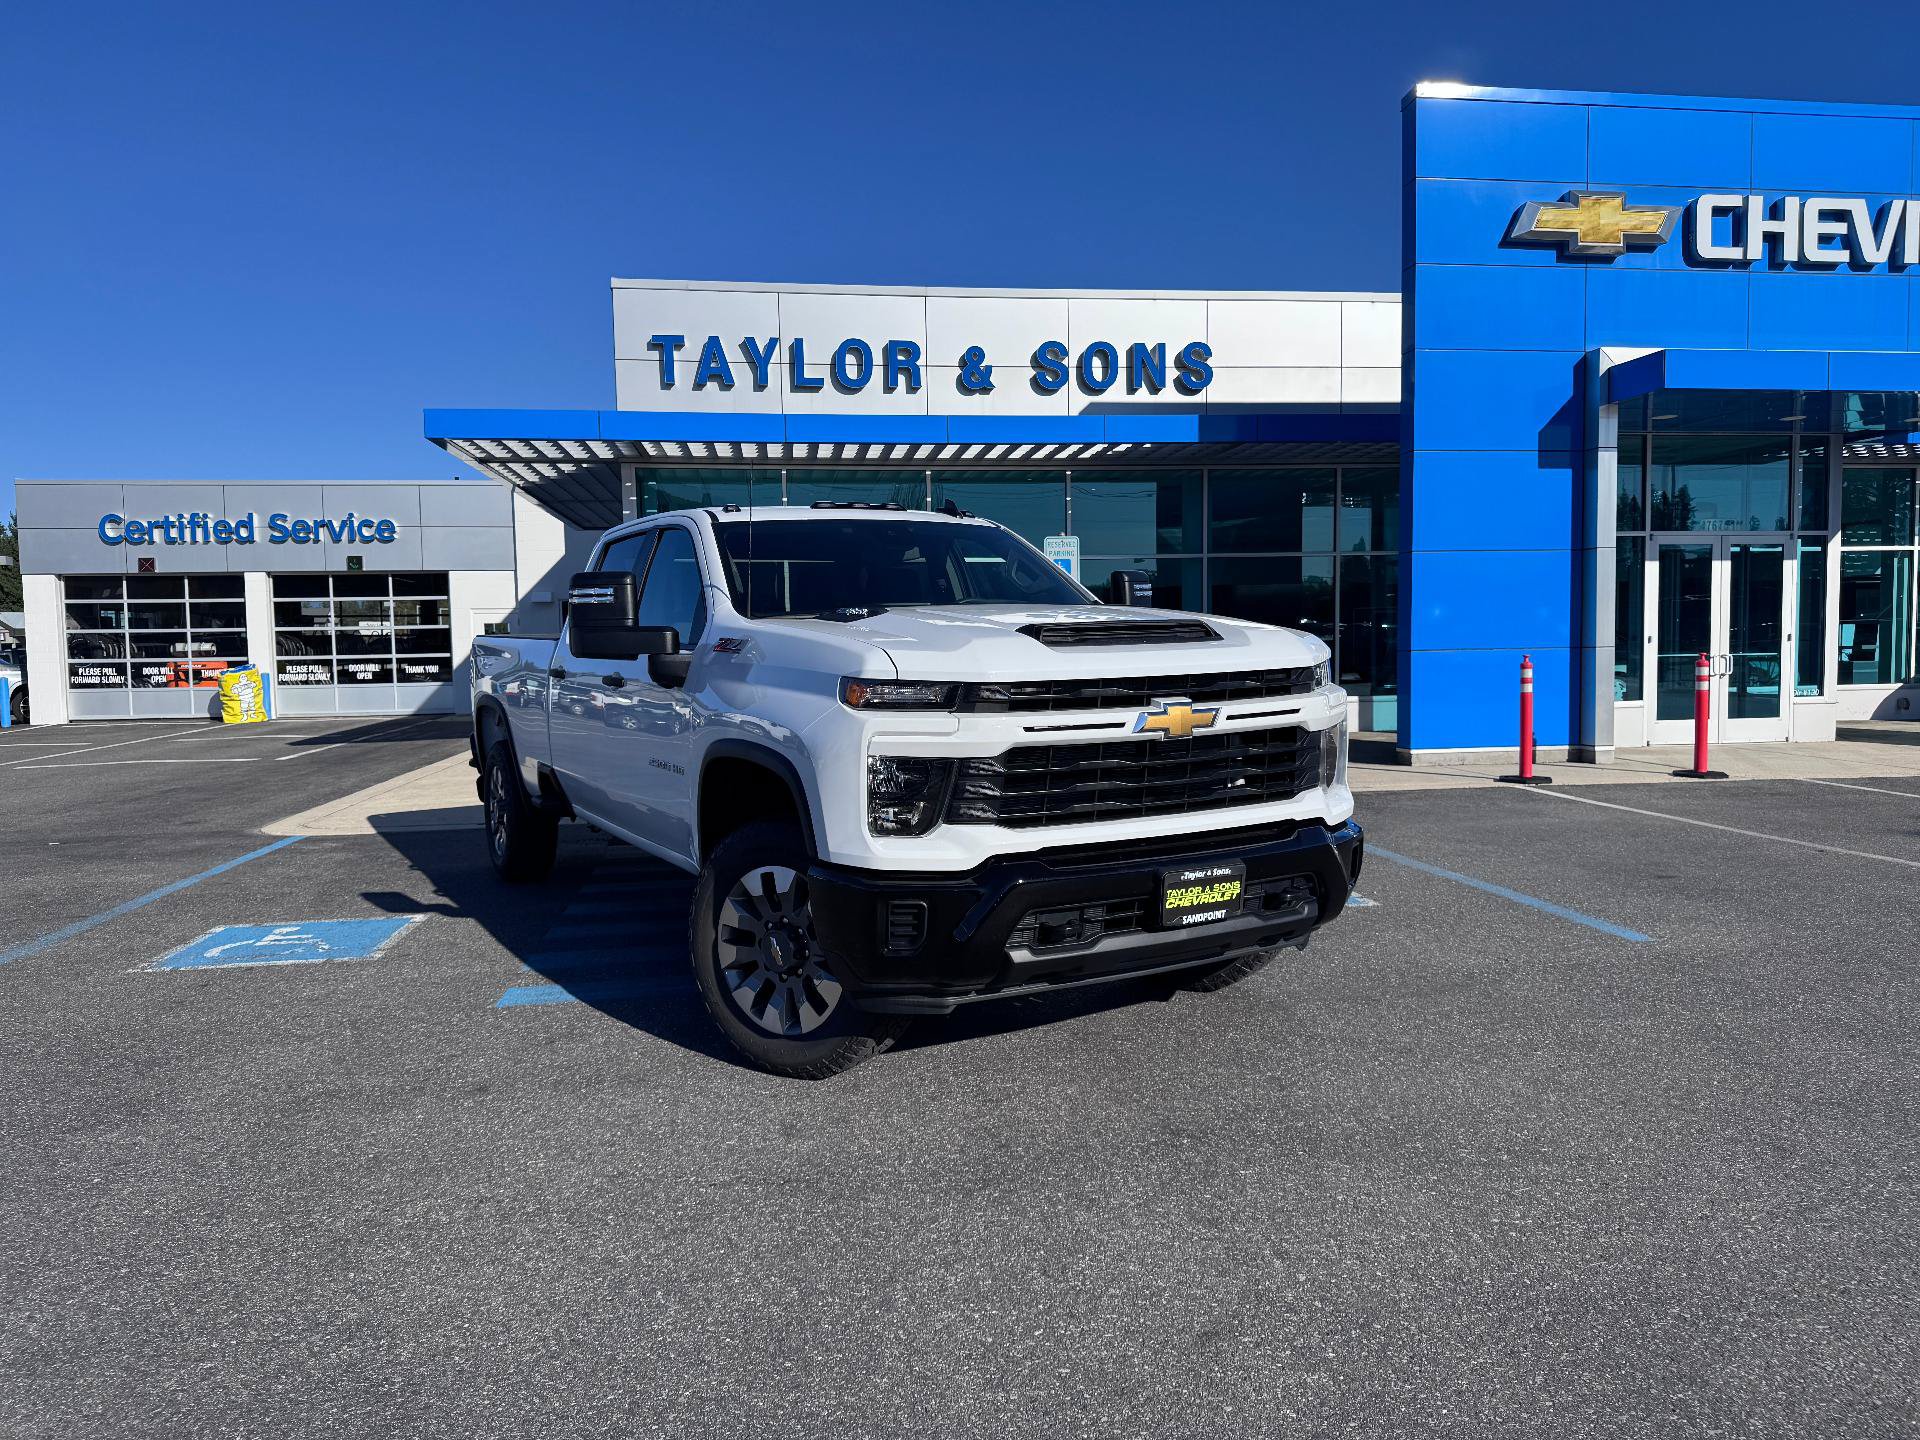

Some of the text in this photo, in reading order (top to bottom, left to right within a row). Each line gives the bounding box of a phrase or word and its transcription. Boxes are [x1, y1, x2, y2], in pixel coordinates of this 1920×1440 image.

[648, 334, 1215, 396] TAYLOR & SONS
[98, 511, 397, 545] Certified Service
[78, 667, 118, 676] PLEASE PULL
[142, 667, 158, 675] DOOR
[159, 666, 175, 675] WILL
[286, 665, 324, 673] PLEASE PULL
[348, 664, 380, 672] DOOR WILL
[405, 665, 440, 674] THANK YOU!
[71, 675, 125, 684] FORWARD SLOWLY
[150, 675, 167, 683] OPEN
[278, 673, 331, 682] FORWARD SLOWLY
[356, 672, 373, 680] OPEN
[1184, 871, 1206, 880] Taylor
[1212, 868, 1229, 876] Sons
[1166, 881, 1241, 899] TAYLOR & SONS
[1165, 889, 1241, 909] CHEVROLET
[1182, 910, 1226, 924] SANDPOINT
